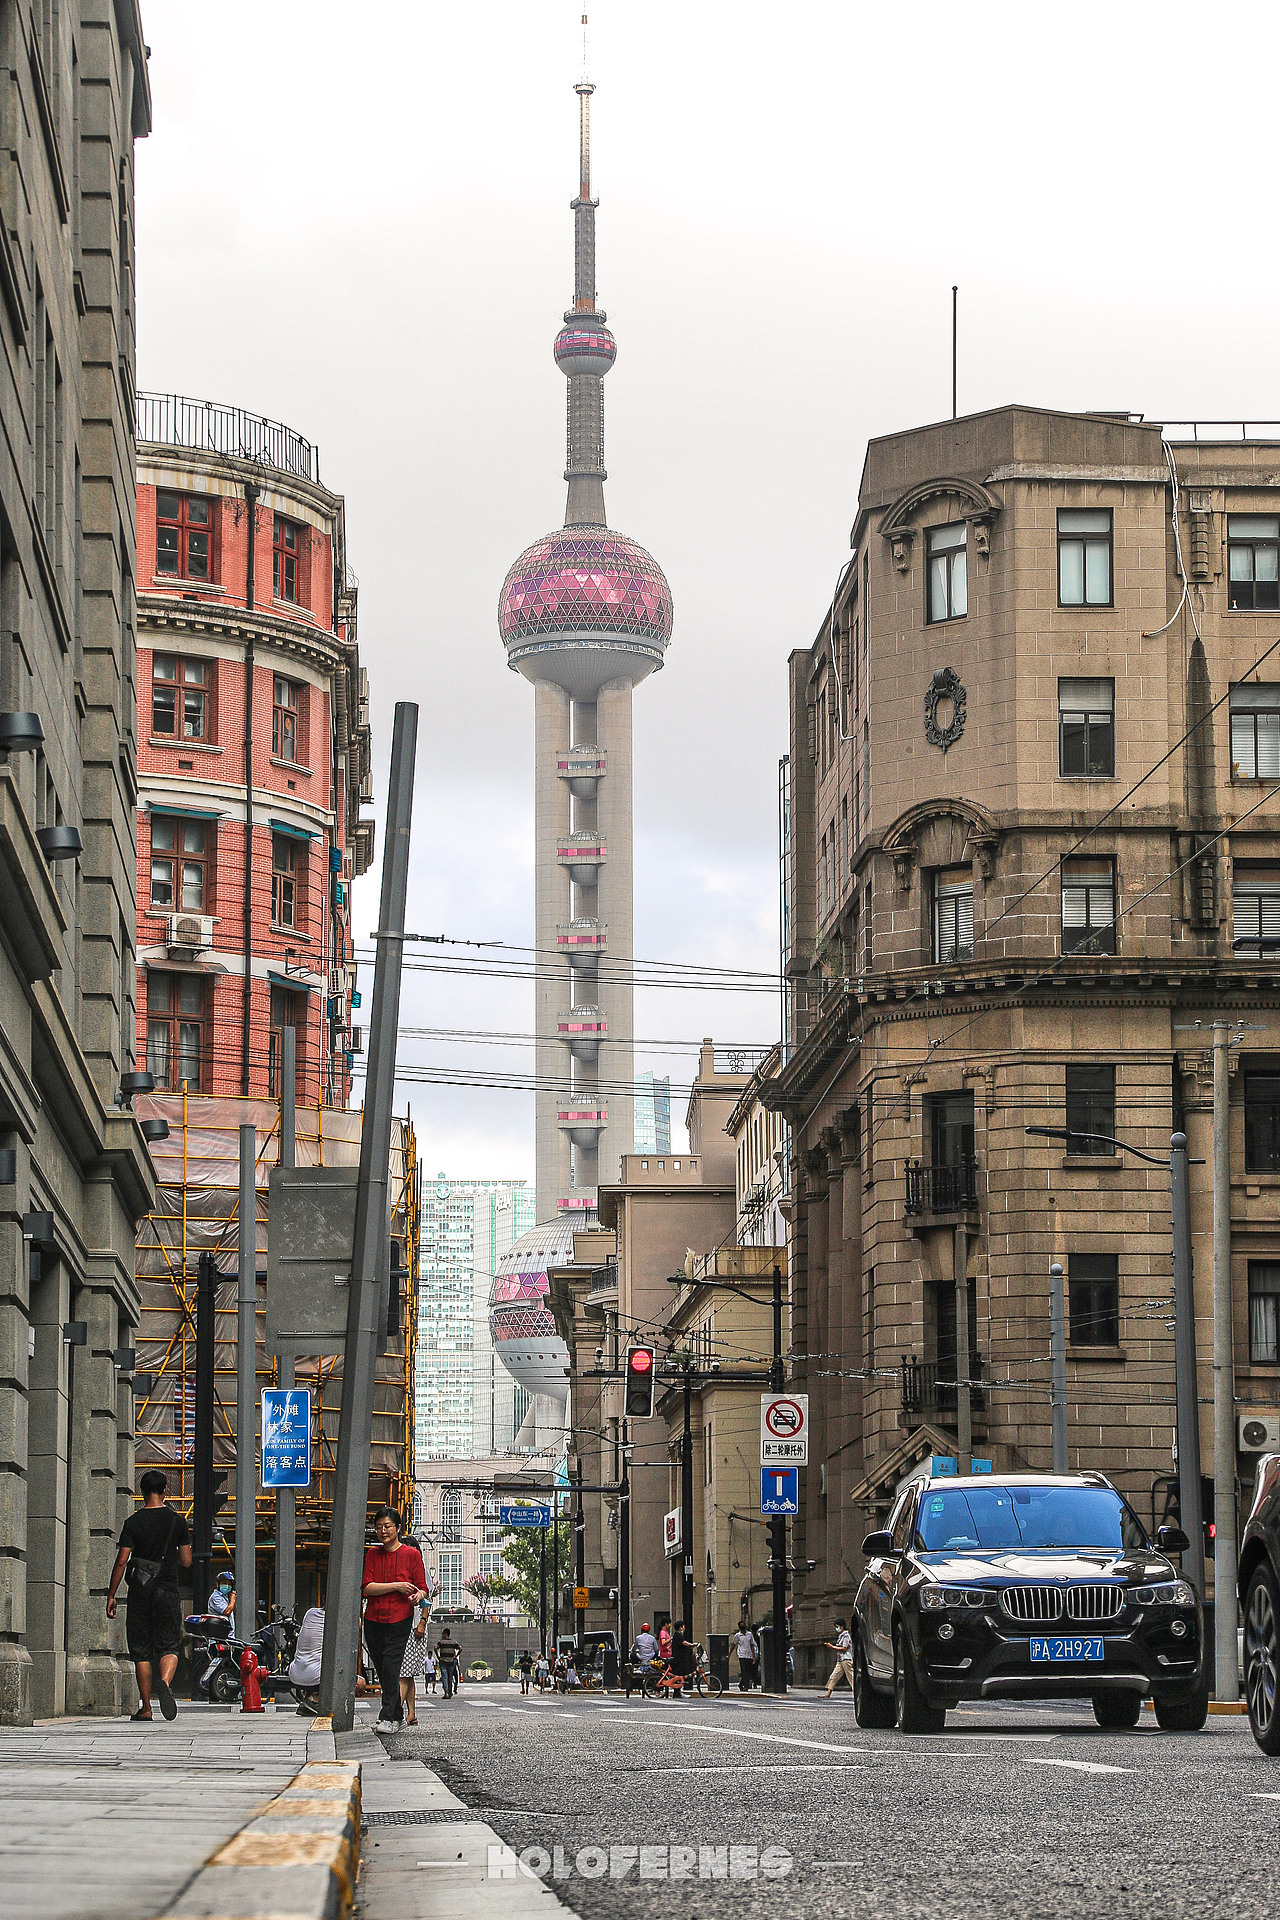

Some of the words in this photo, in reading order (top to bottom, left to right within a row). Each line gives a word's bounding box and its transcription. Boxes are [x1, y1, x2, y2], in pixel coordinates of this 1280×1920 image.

[272, 1404, 298, 1416] 外滩
[266, 1420, 306, 1434] 林家一
[764, 1444, 803, 1456] 除二轮摩托外
[266, 1456, 306, 1468] 落客点
[1032, 1640, 1102, 1658] 沪A·2H927
